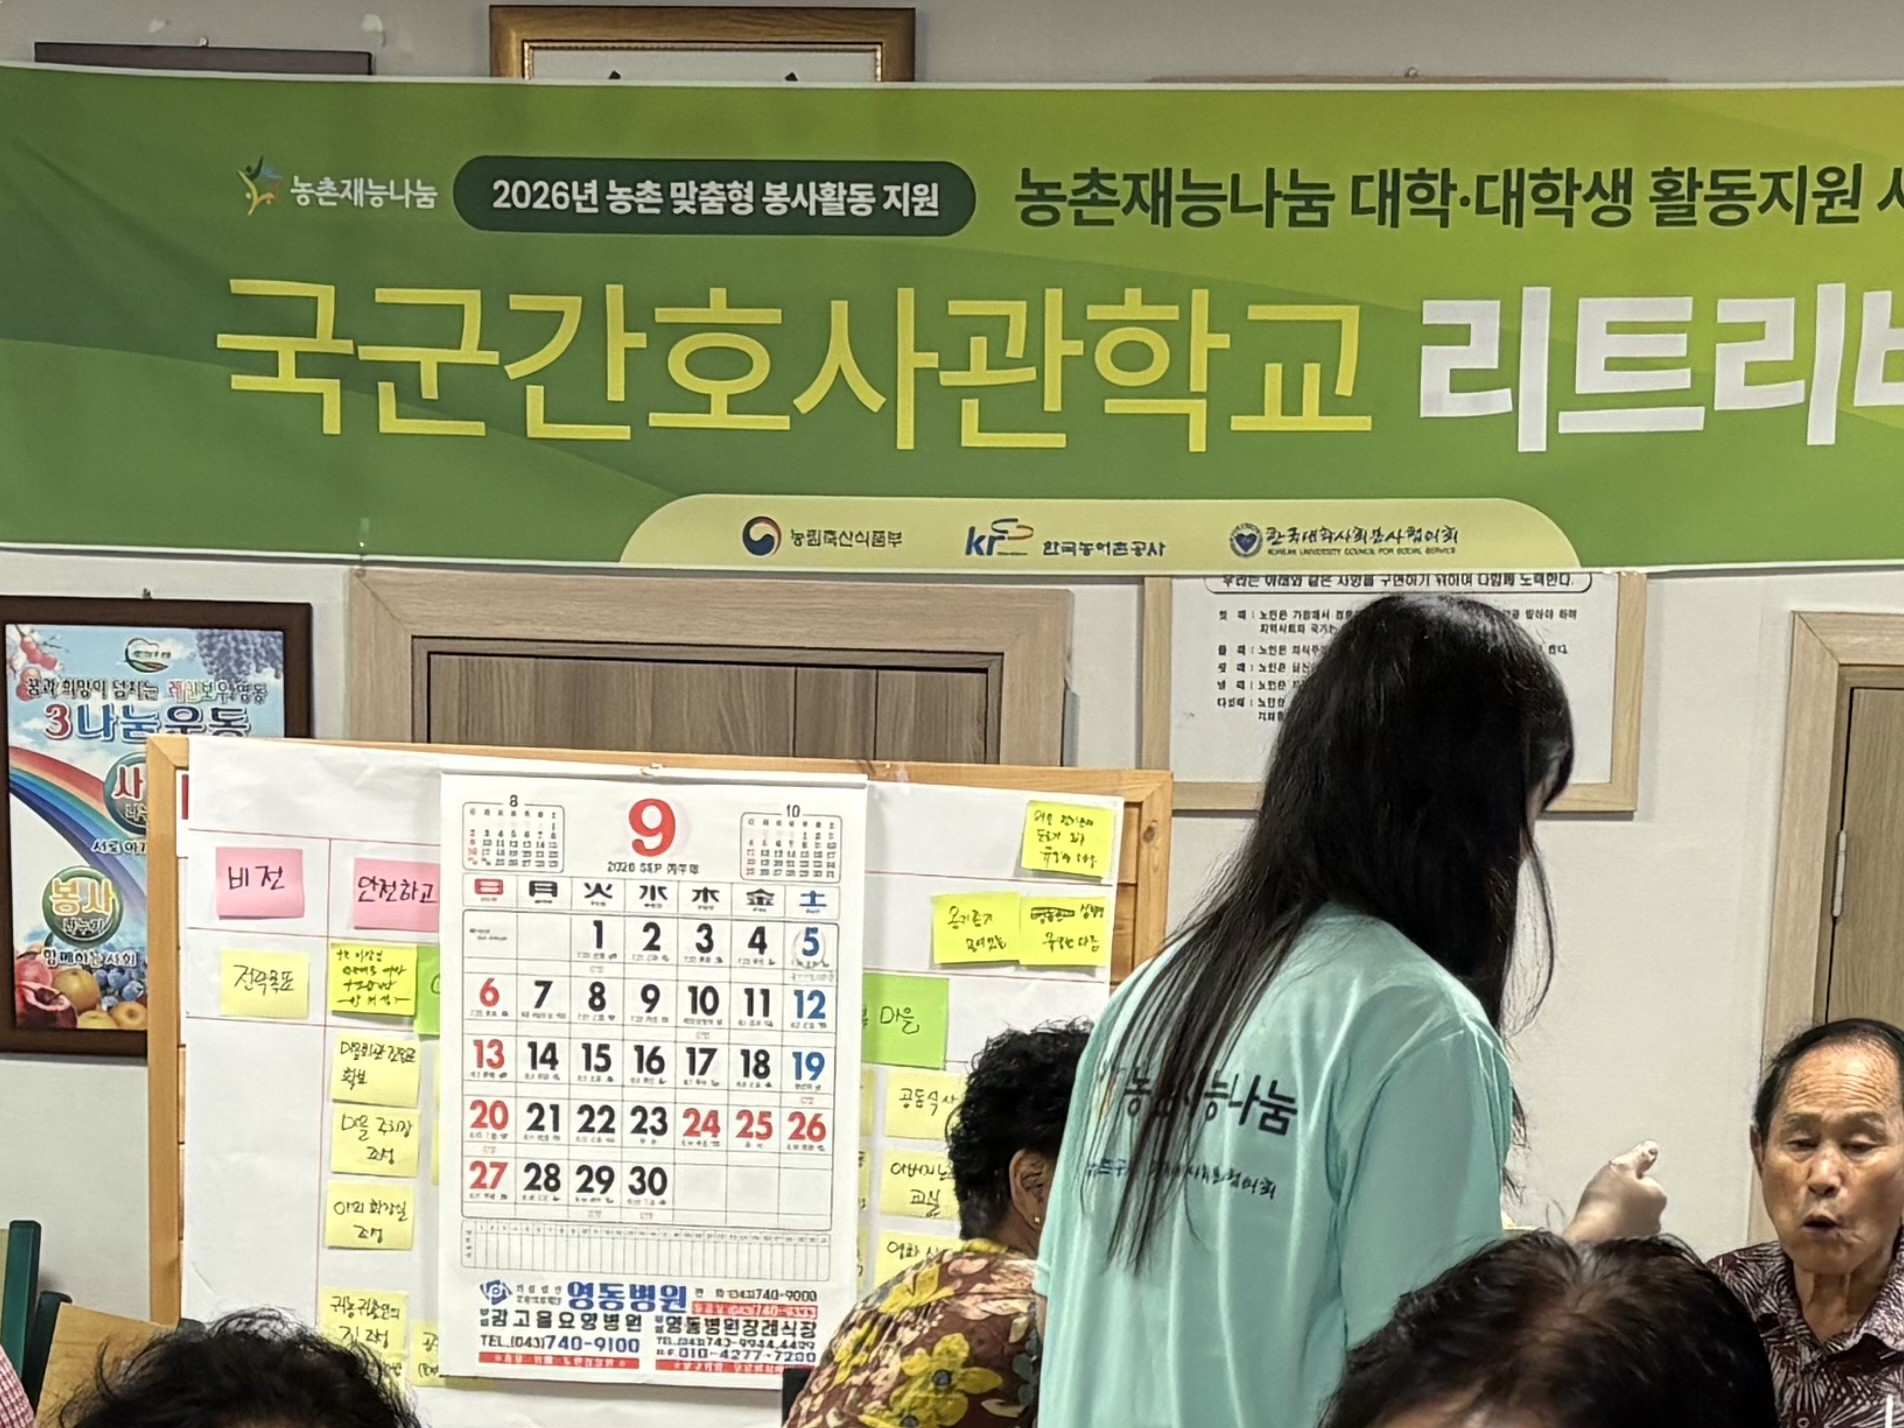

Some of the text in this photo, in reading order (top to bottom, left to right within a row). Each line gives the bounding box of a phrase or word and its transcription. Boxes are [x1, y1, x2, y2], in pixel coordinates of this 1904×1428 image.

[290, 175, 439, 209] 농촌재능나눔
[492, 179, 940, 220] 2026년 농촌 맞춤형 봉사활동 지원
[1014, 166, 1335, 228] 농촌재능나눔
[1349, 164, 1637, 228] 대학·대학생
[1649, 162, 1866, 228] 활동지원
[215, 277, 1374, 454] 국군간호사관학교
[1042, 540, 1168, 558] 한국농어촌공사
[509, 794, 801, 858] 8 9 10
[475, 879, 828, 907] 日 月 火 水 木 金 土
[593, 919, 820, 957] 1 2 3 4 5
[479, 977, 826, 1020] 6 7 8 9 10 11 12
[472, 1038, 825, 1081] 13 14 15 16 17 18 19
[469, 1099, 827, 1143] 20 21 22 23 24 25 26
[468, 1160, 668, 1197] 27 28 29 30
[567, 1281, 688, 1314] 영동병원
